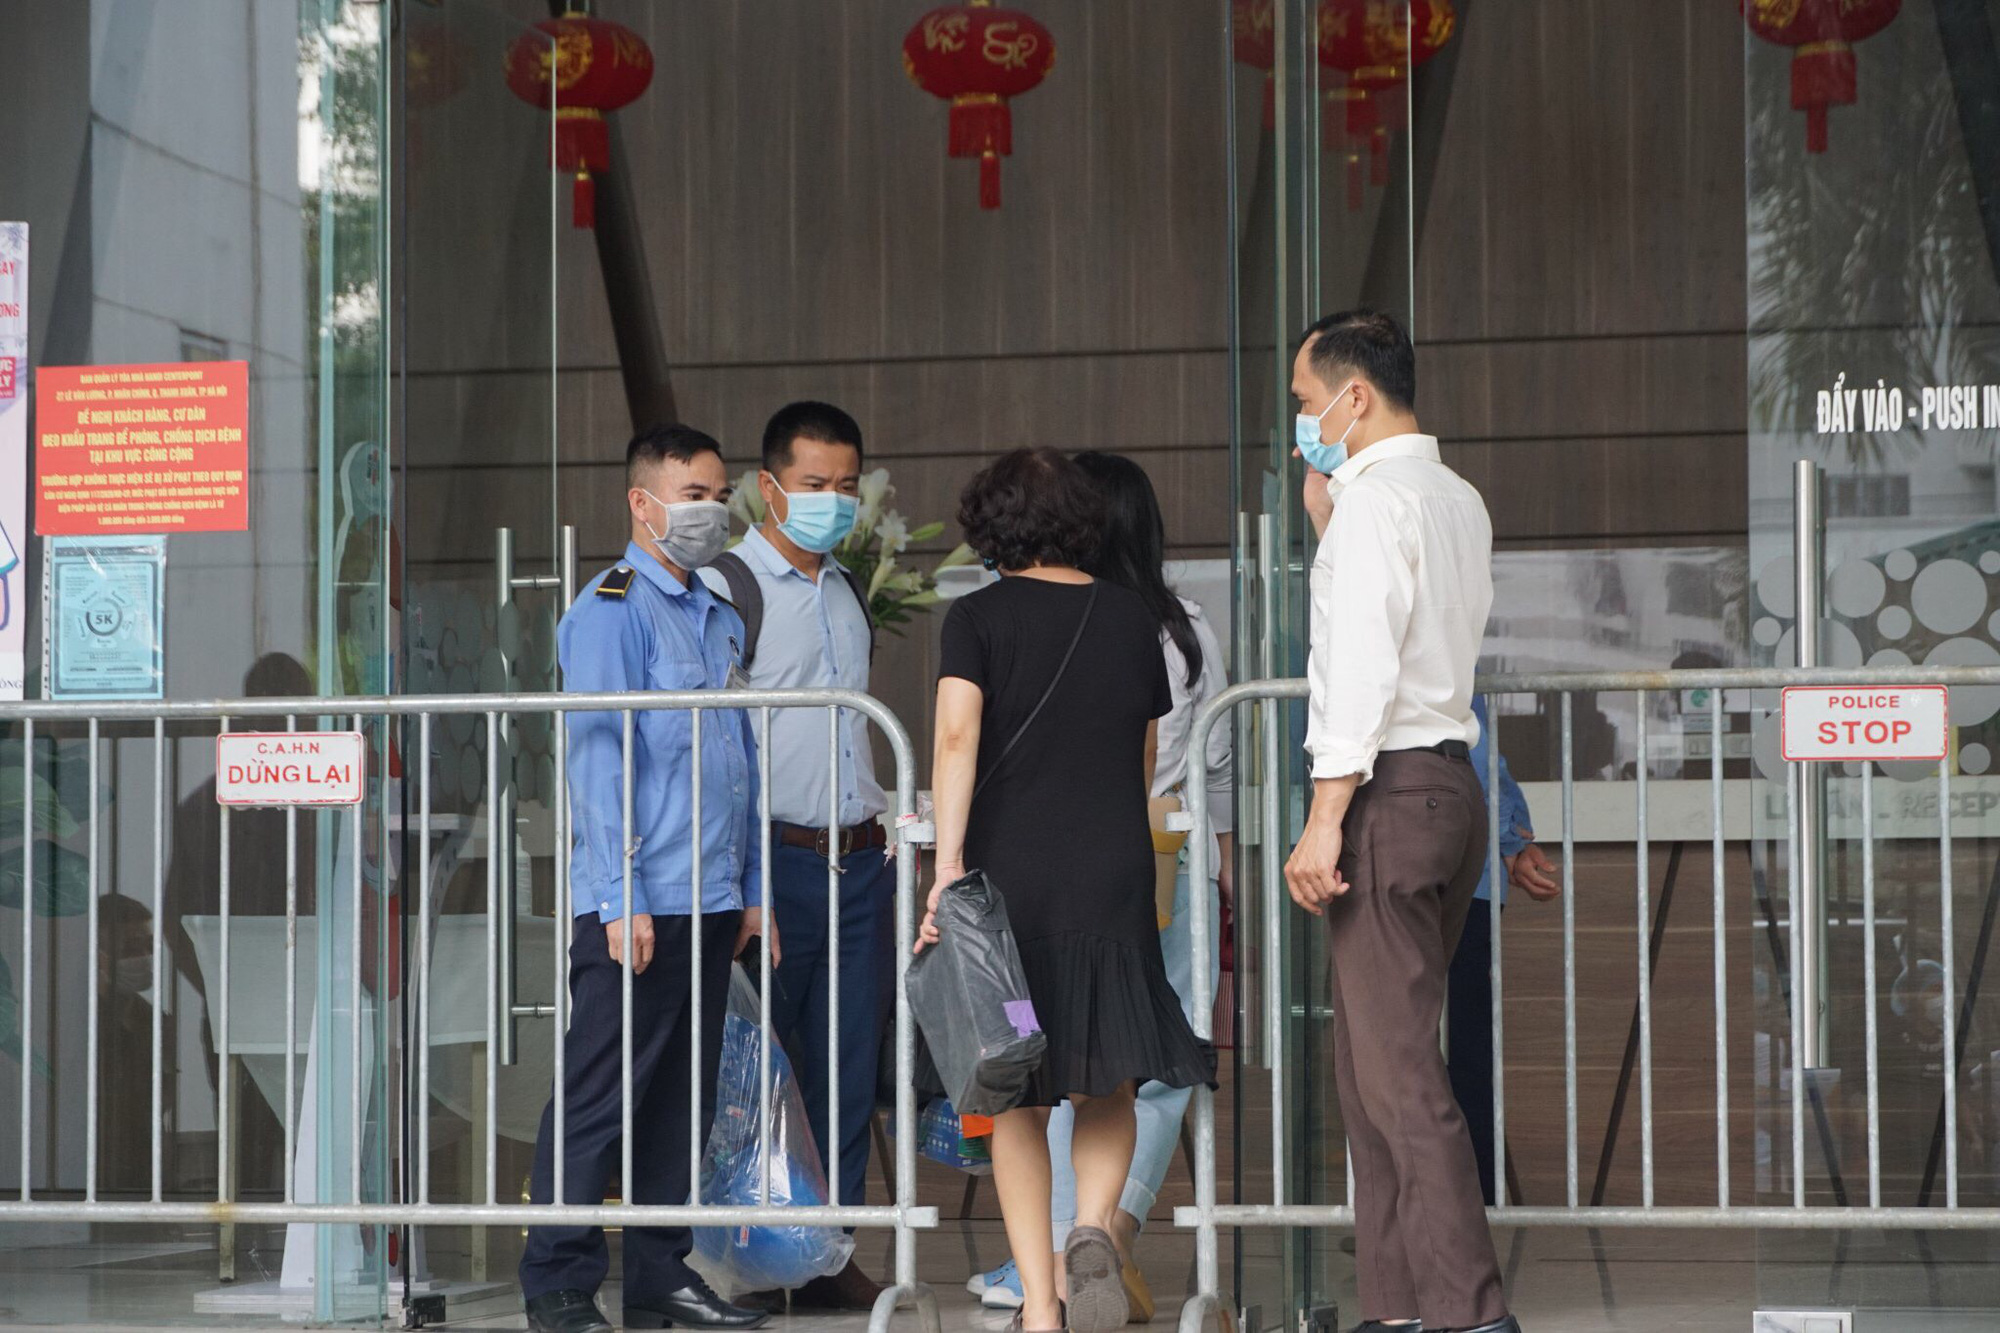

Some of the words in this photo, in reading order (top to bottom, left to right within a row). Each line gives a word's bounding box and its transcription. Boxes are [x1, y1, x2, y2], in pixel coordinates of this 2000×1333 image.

[1816, 371, 1857, 434] ĐẨY
[1862, 379, 1903, 432] VÀO
[1922, 385, 1979, 431] PUSH
[86, 432, 115, 446] TRANG
[95, 614, 113, 625] 5K
[1829, 695, 1900, 709] POLICE
[1817, 720, 1912, 744] STOP
[257, 742, 320, 754] C.A.H.N
[307, 764, 350, 789] LẠI
[1901, 791, 2000, 818] RECEP
